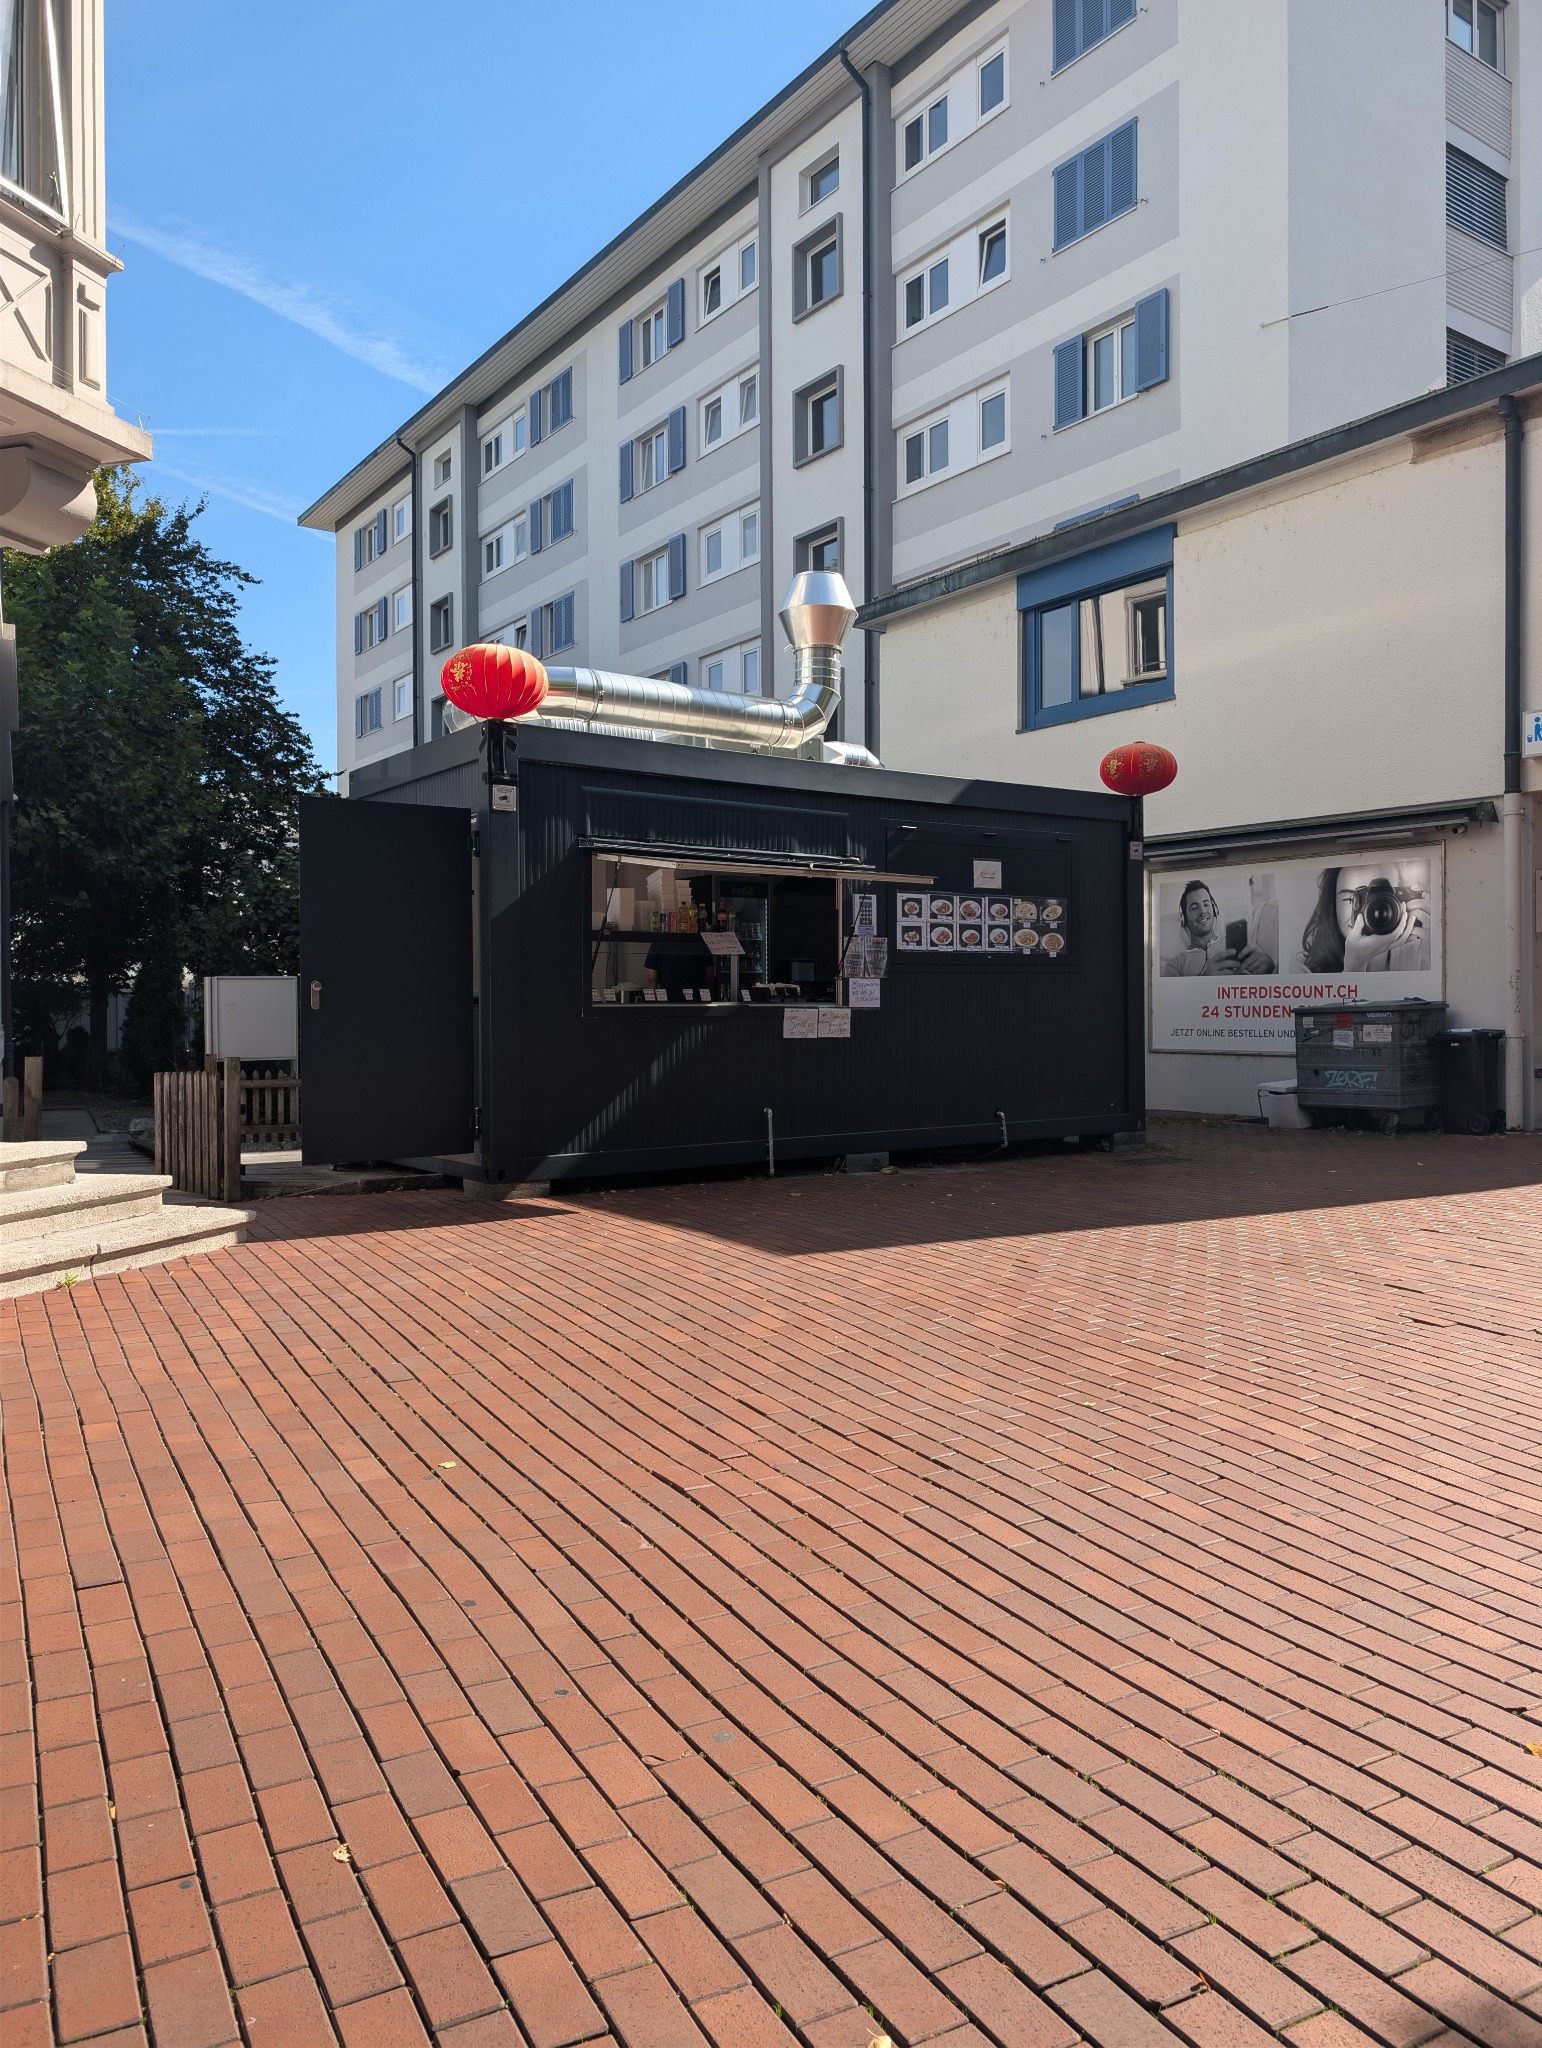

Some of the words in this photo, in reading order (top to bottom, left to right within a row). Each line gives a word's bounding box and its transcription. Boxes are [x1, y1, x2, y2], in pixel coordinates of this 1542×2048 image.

[1217, 984, 1358, 999] INTERDISCOUNT.CH
[1201, 1005, 1219, 1018] 24
[1224, 1005, 1292, 1018] STUNDEN
[1170, 1028, 1194, 1037] JETZT
[1196, 1028, 1226, 1037] ONLINE
[1228, 1029, 1274, 1038] BESTELLEN
[1277, 1029, 1296, 1038] UND
